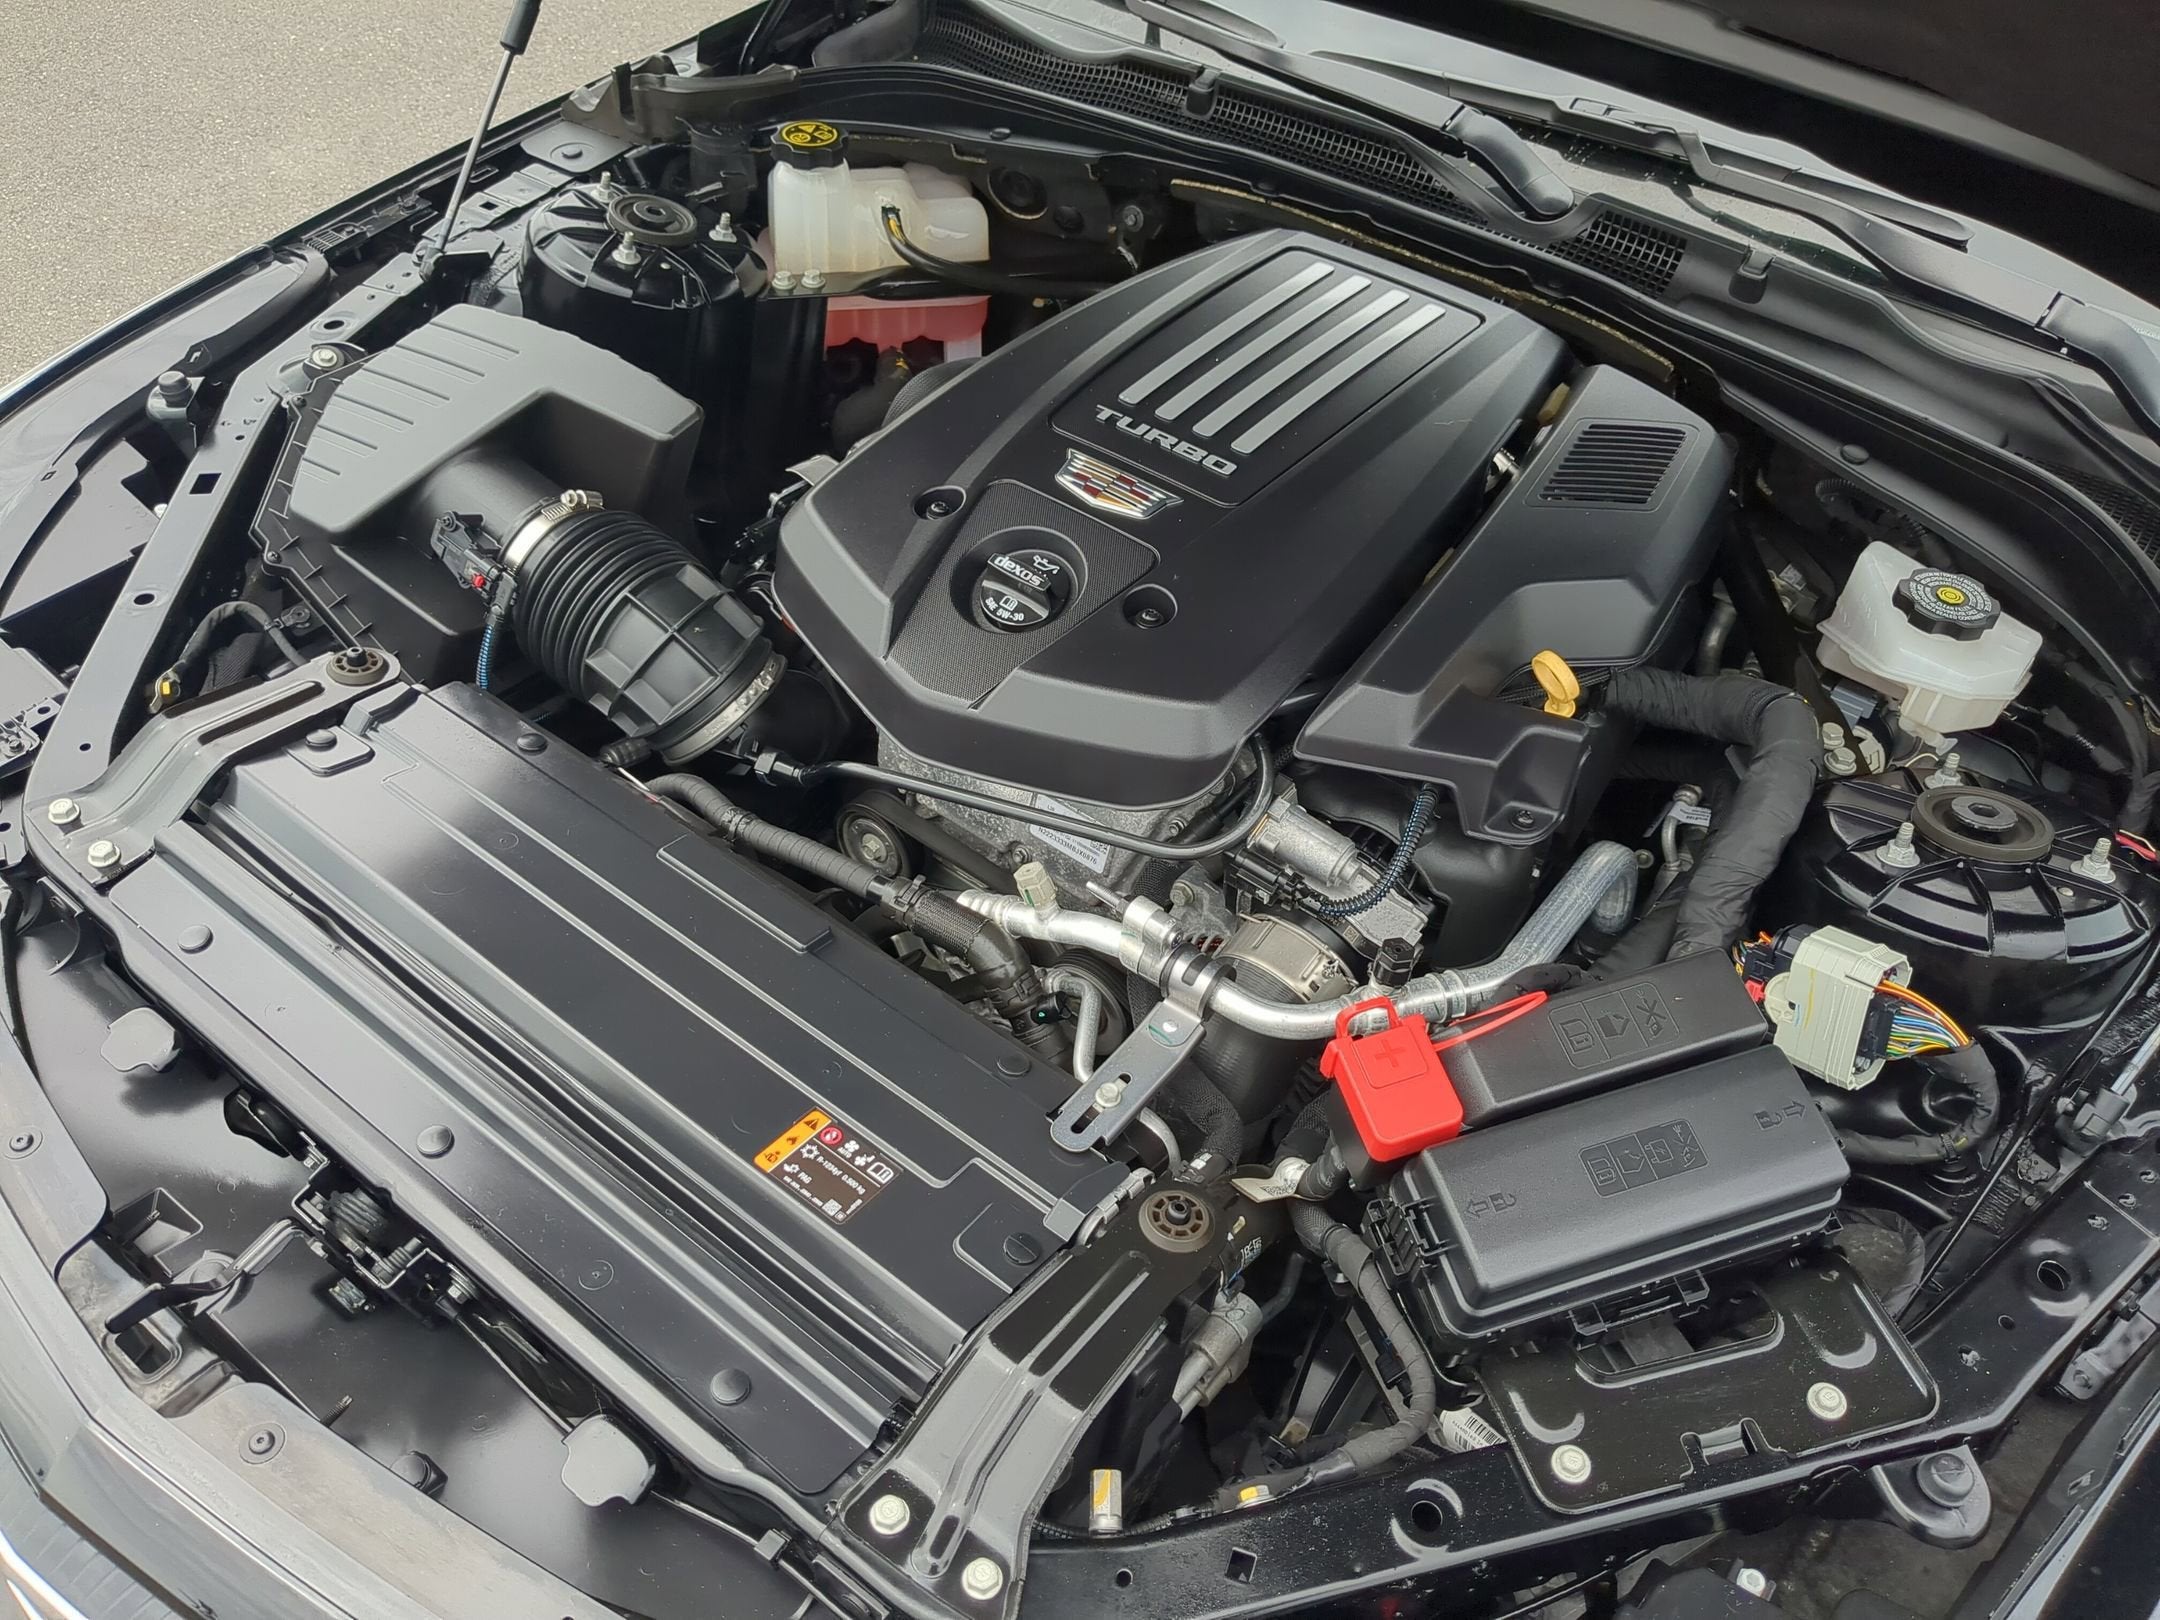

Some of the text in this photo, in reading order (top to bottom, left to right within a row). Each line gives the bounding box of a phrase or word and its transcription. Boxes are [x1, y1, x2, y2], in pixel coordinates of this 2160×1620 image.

[1095, 404, 1237, 477] TURBO
[994, 556, 1045, 586] dexos
[985, 597, 1025, 621] SAE 5W-30
[798, 1171, 813, 1184] PAG
[856, 1185, 866, 1195] kg
